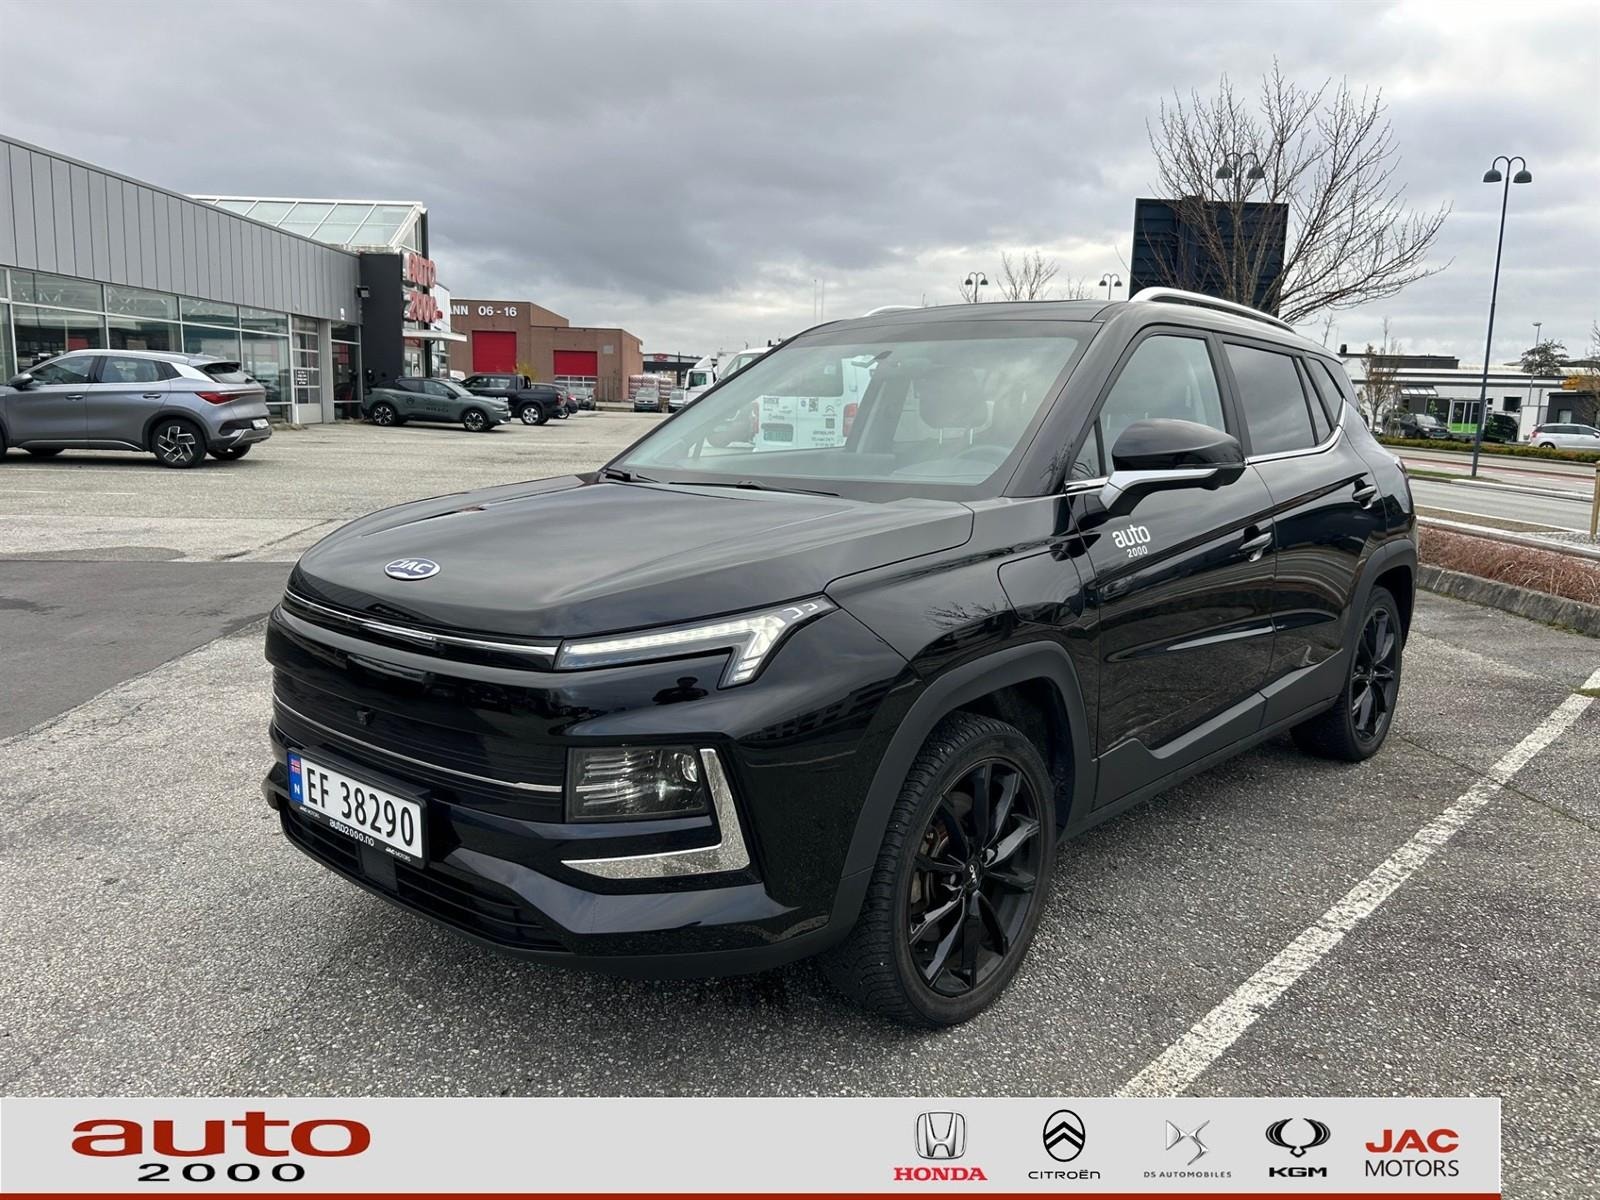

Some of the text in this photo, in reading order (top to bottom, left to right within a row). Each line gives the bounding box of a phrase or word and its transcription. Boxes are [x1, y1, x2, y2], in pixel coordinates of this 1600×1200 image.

[478, 305, 494, 316] 06
[504, 306, 517, 317] 16
[1112, 524, 1151, 548] auto
[1126, 545, 1148, 558] 2000
[389, 559, 434, 574] JAC
[294, 784, 300, 794] N
[306, 767, 414, 847] EF 38290
[329, 818, 375, 847] auto2000.no
